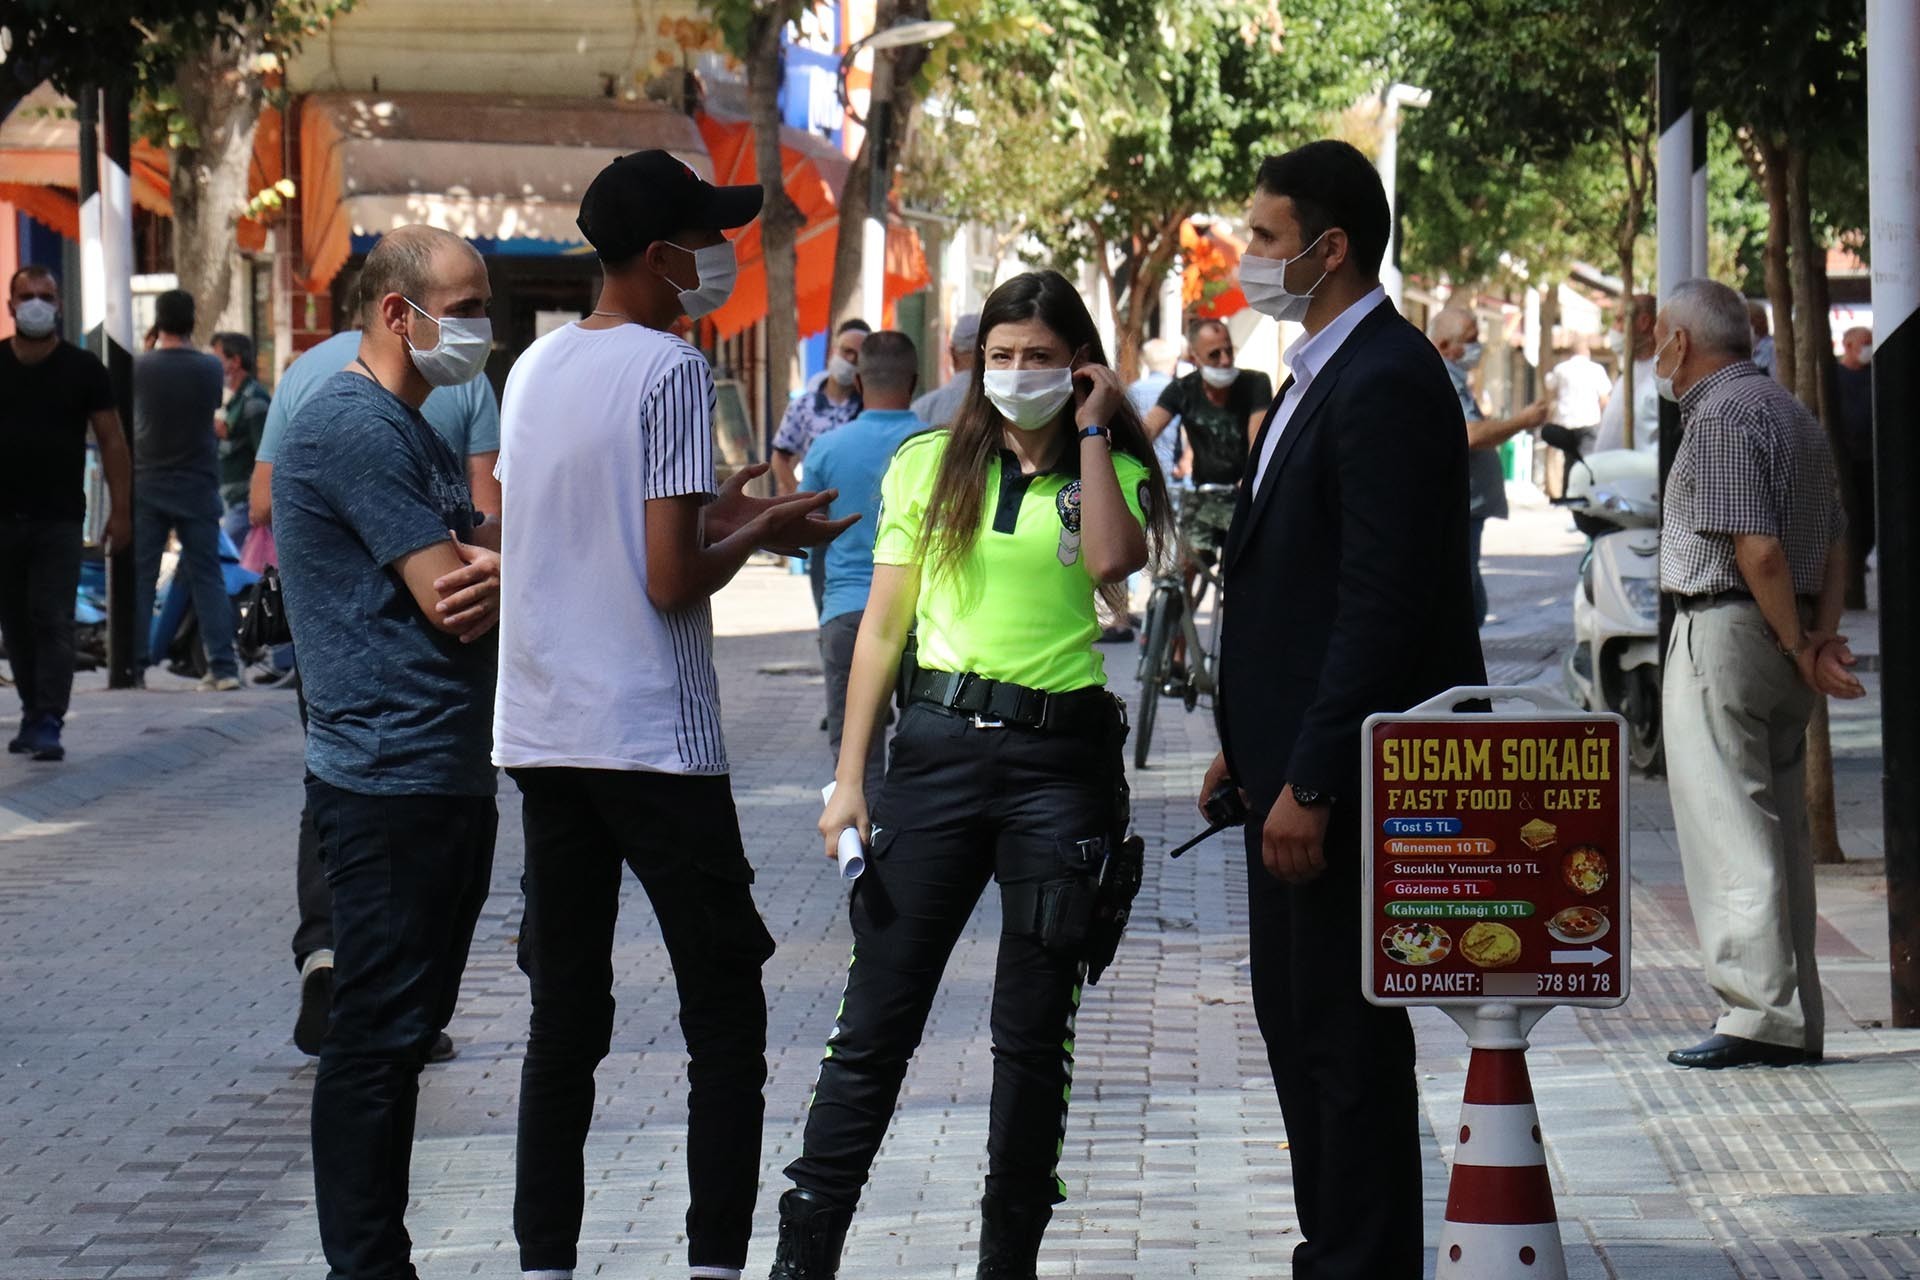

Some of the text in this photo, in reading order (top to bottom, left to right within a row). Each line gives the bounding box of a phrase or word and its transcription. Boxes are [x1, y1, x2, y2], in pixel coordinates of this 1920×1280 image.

[1383, 727, 1610, 781] SUSAM SOKAĞI
[1388, 789, 1601, 810] FAST FOOD & CAFE
[1393, 821, 1452, 832] Tost 5 TL
[1391, 842, 1490, 853] Menemen 10 TL
[1393, 863, 1540, 874] Sucuklu Yumurta 10 TL
[1395, 883, 1480, 894] Gözleme 5 TL
[1391, 904, 1526, 917] Kahvaltı Tabağı 10 TL
[1383, 973, 1417, 992] ALO
[1421, 973, 1480, 992] PAKET:
[1567, 973, 1585, 992] 91
[1591, 973, 1611, 992] 78
